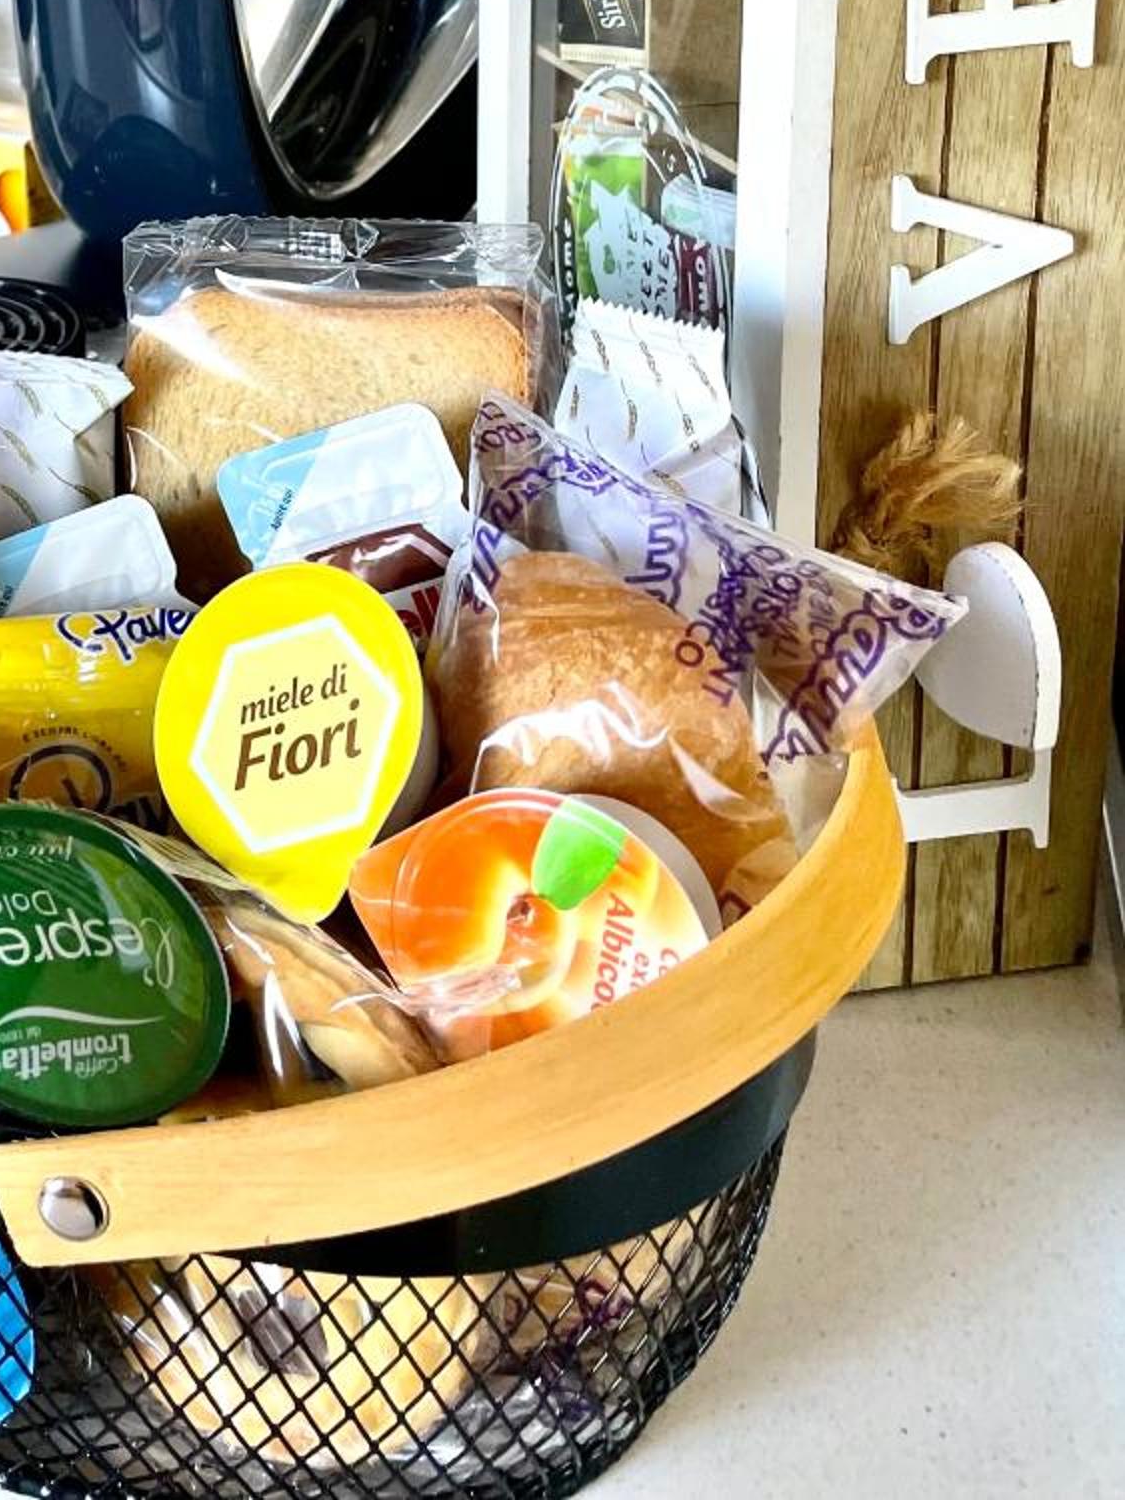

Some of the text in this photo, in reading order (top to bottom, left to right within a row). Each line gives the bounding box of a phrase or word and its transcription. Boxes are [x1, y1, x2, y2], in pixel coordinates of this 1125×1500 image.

[597, 0, 626, 30] Sir
[56, 607, 197, 661] Pave
[241, 662, 348, 725] miele di
[234, 698, 362, 791] Fiori
[1, 1032, 134, 1081] trombetta
[74, 1053, 118, 1079] Caffè
